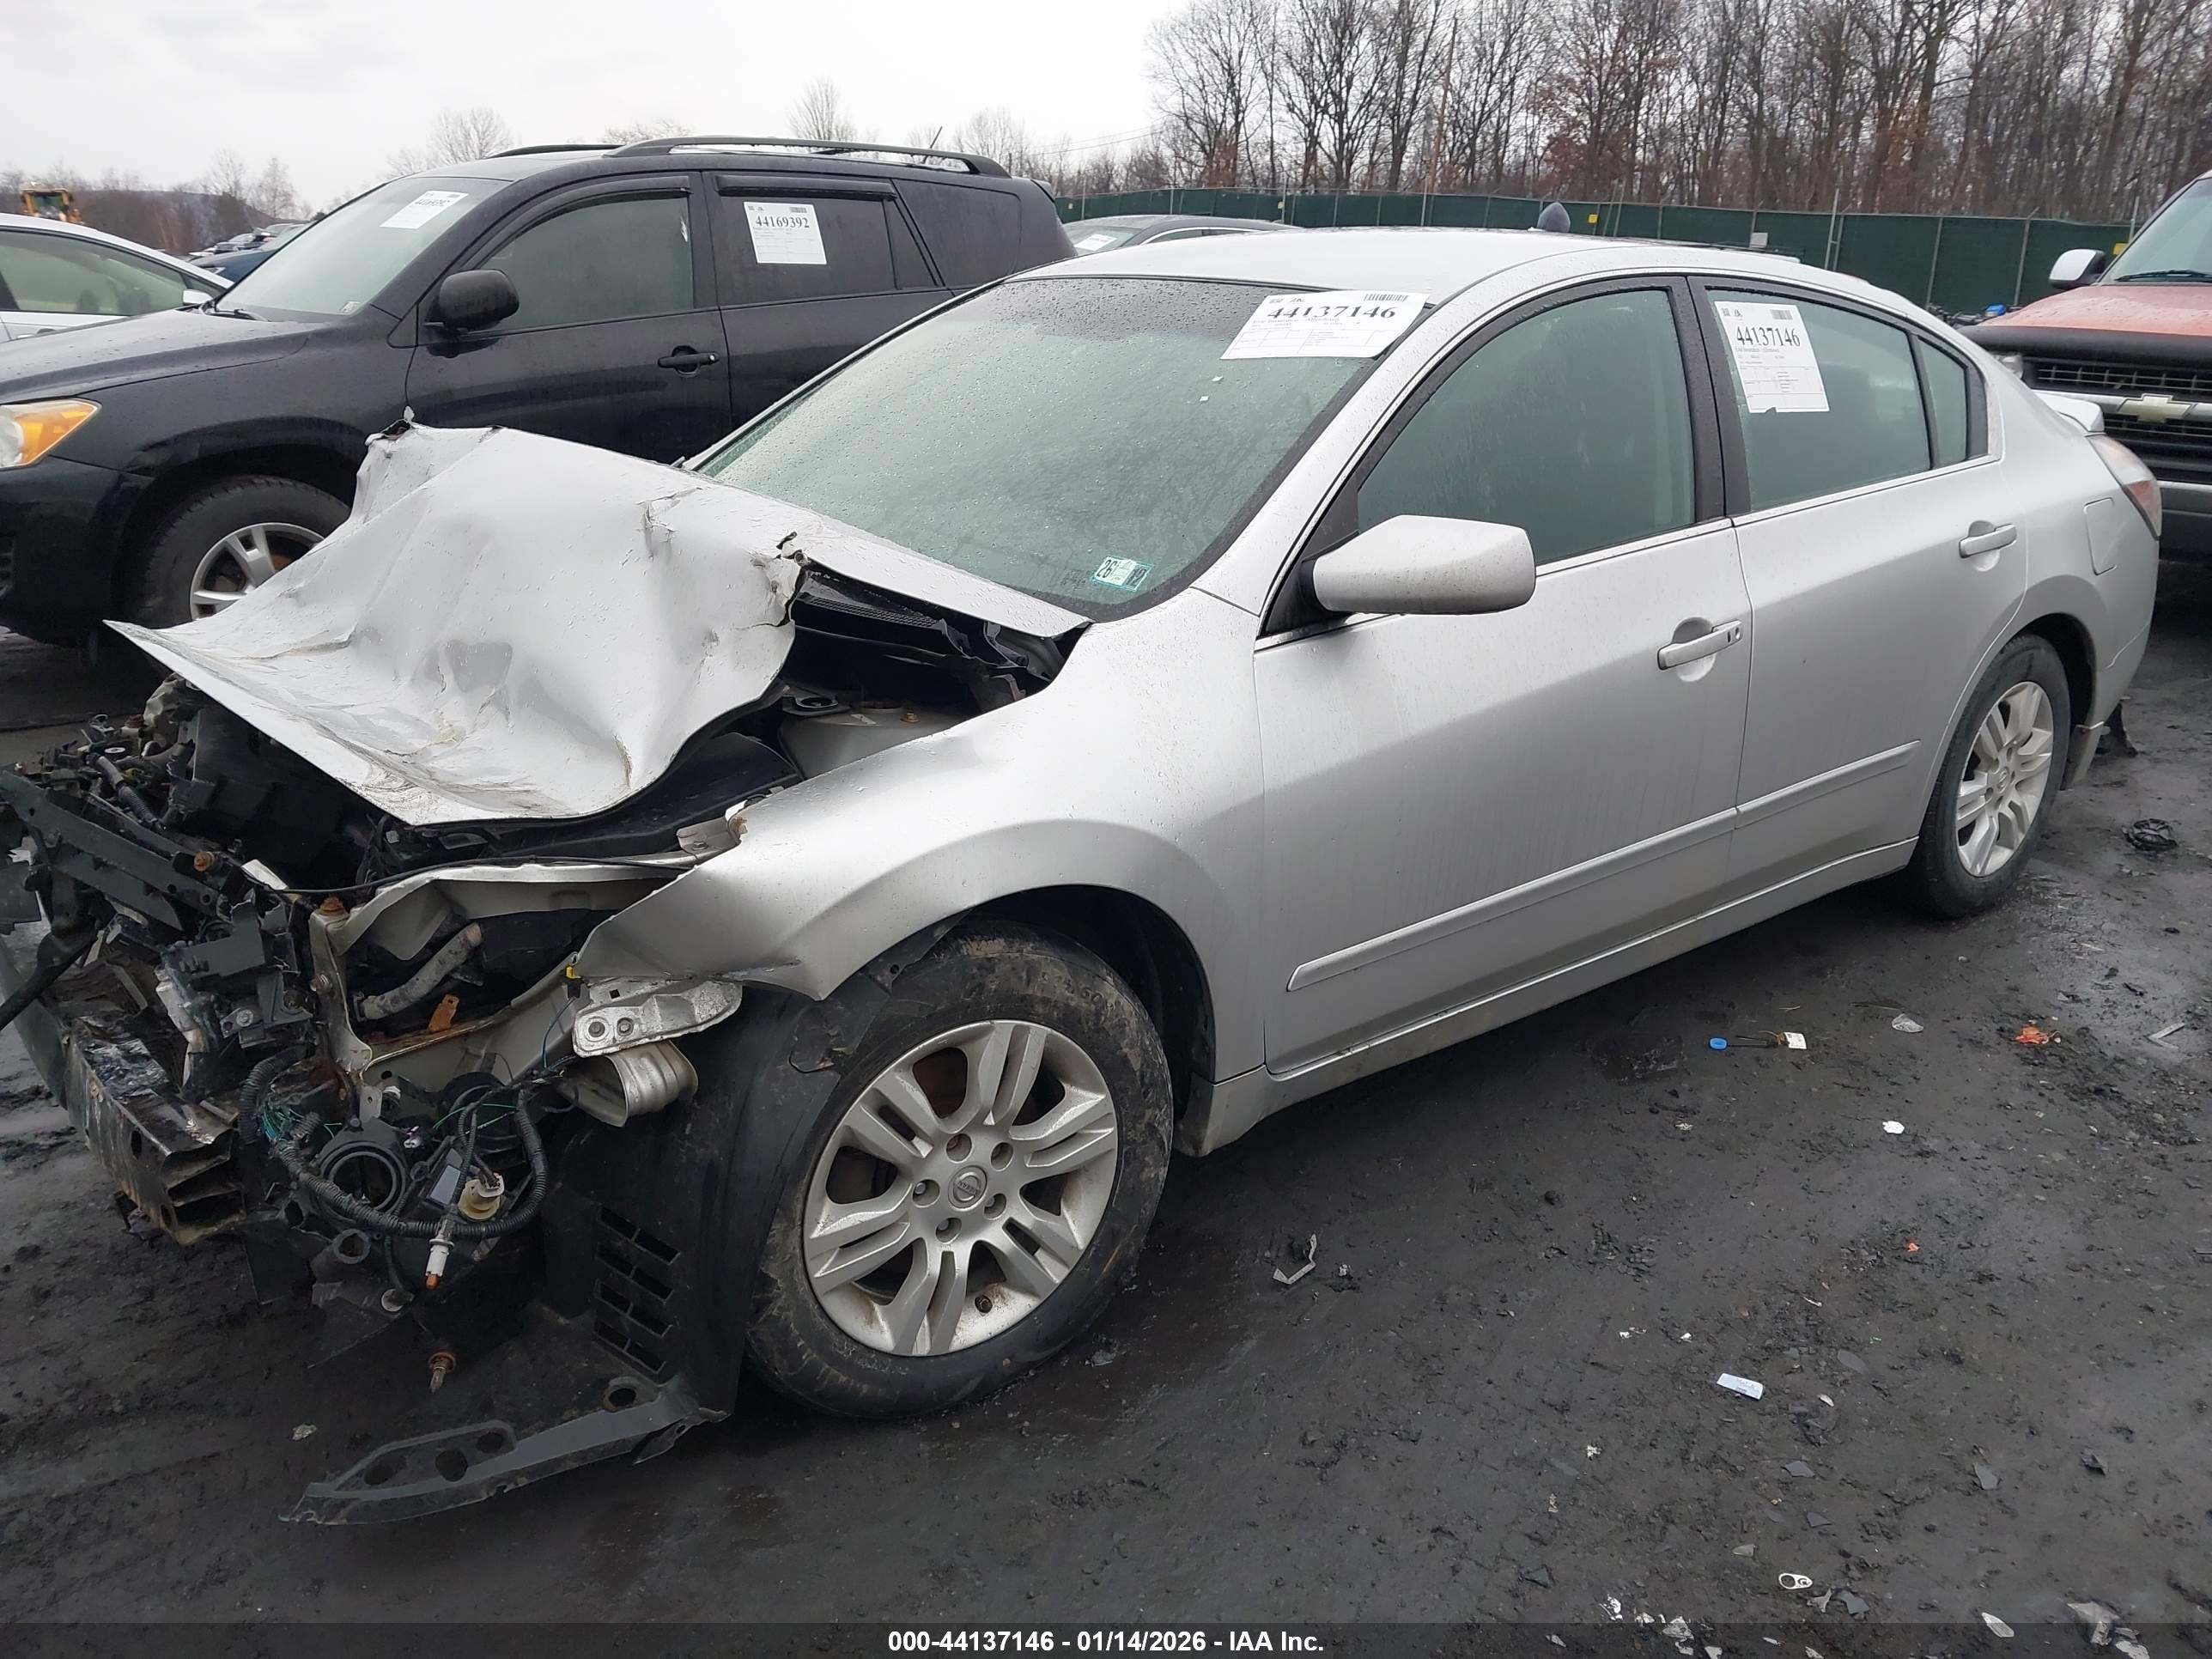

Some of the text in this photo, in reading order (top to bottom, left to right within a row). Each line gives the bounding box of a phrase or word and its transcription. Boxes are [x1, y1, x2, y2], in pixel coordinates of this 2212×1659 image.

[756, 216, 810, 228] 44169392
[1267, 305, 1397, 319] 44137146
[1736, 325, 1801, 347] 44137146
[1096, 558, 1118, 579] 26
